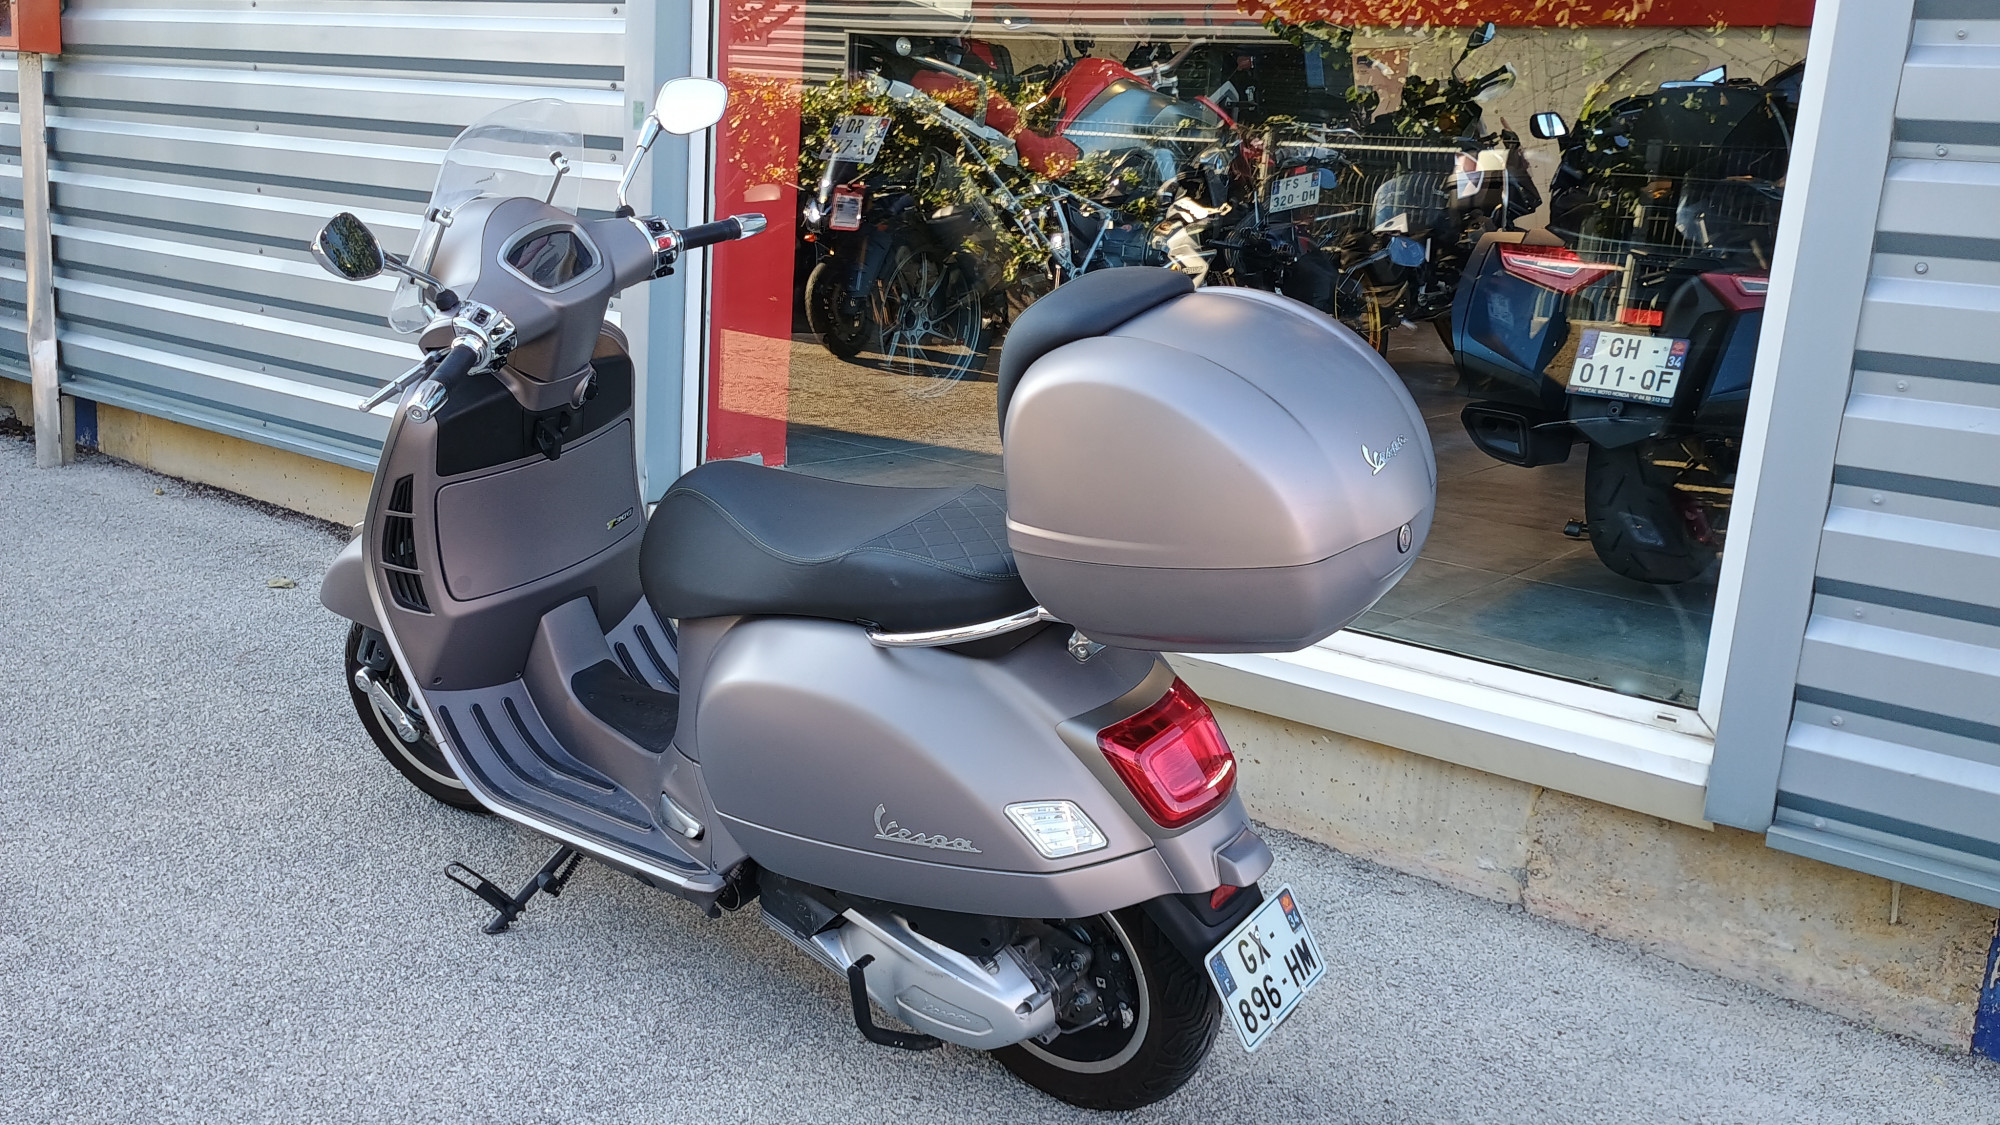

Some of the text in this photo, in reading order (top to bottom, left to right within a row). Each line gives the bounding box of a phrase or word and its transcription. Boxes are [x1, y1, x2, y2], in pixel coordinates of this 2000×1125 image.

[846, 119, 864, 134] DR
[1273, 190, 1316, 207] 320-DH
[1667, 356, 1682, 368] 34
[1361, 433, 1408, 476] Vespa
[873, 803, 983, 853] Vespa
[1287, 911, 1301, 929] 34
[1239, 937, 1317, 1033] 896-HM
